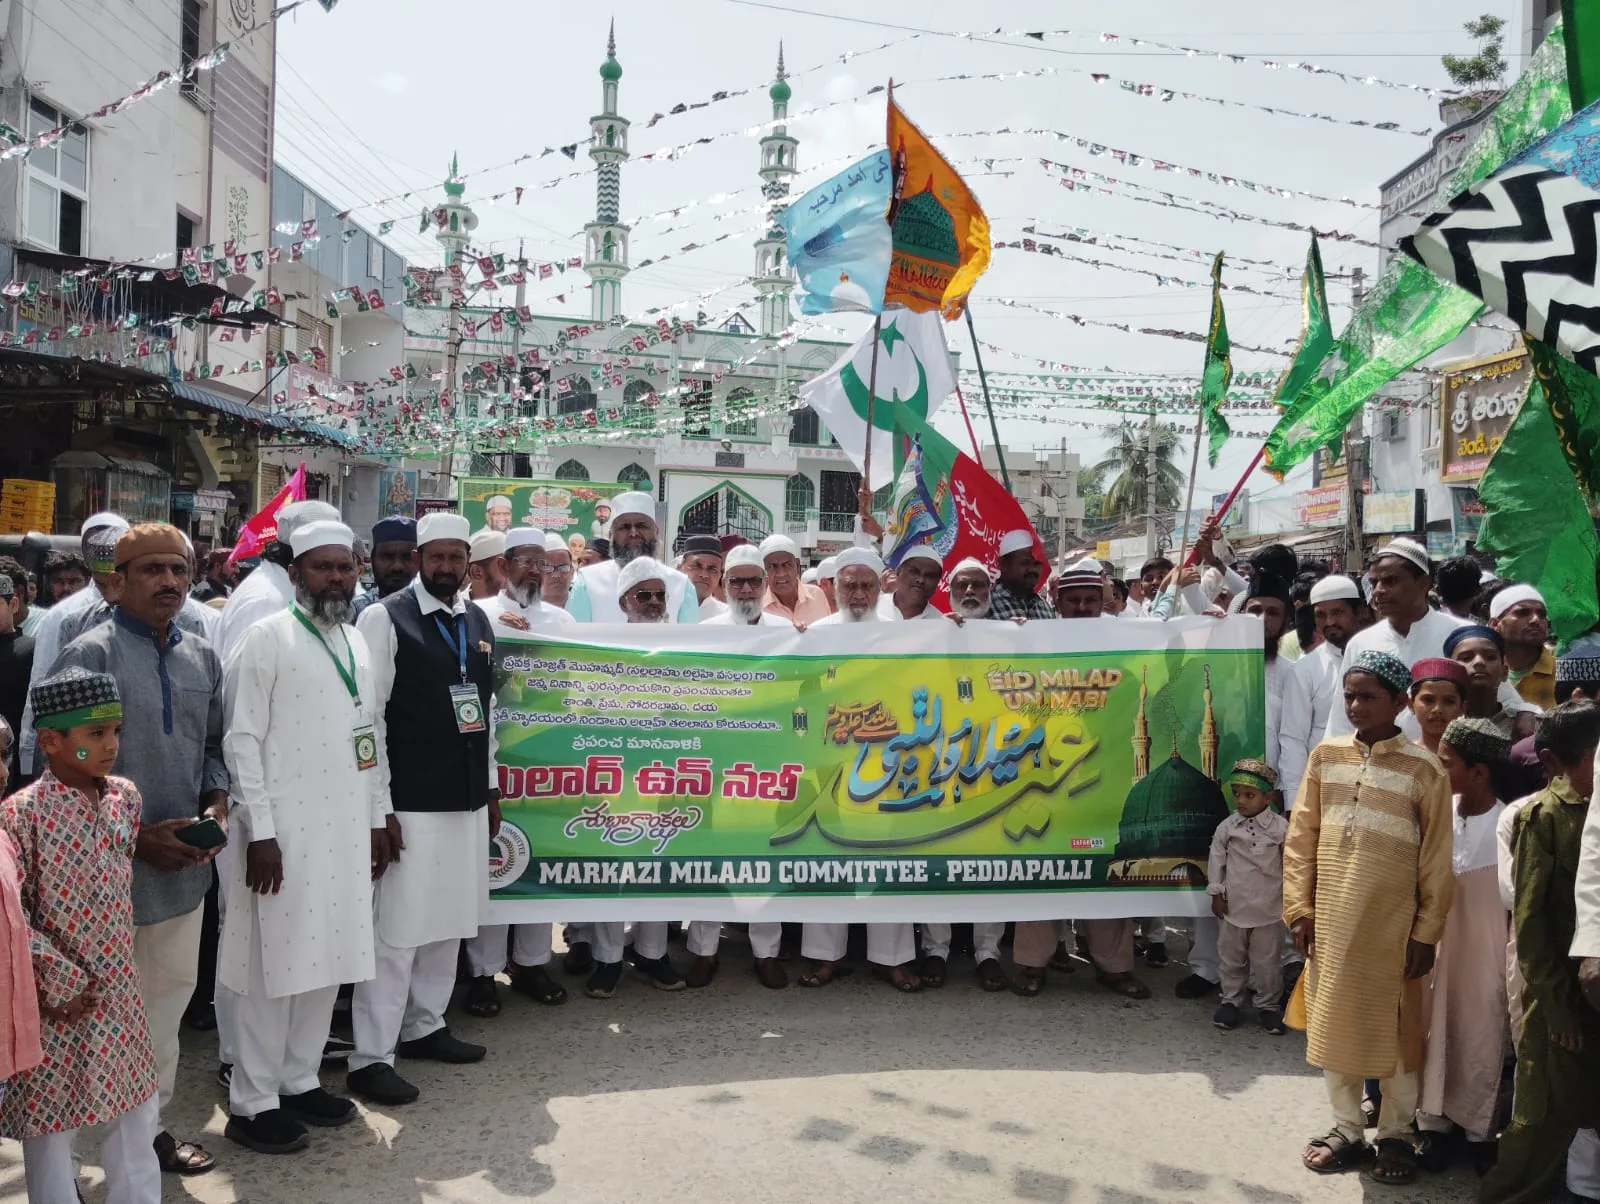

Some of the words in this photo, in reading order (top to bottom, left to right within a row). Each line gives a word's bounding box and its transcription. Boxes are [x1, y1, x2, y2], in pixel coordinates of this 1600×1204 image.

[985, 669, 1035, 691] EID
[1039, 666, 1123, 690] MILAD
[1002, 689, 1044, 712] UN
[1049, 689, 1108, 711] NABI
[572, 736, 623, 750] ప్రపంచ
[634, 758, 713, 797] ఉన్
[538, 861, 661, 885] MARKAZI
[669, 860, 771, 884] MILAAD
[778, 860, 929, 884] COMMITTEE
[946, 859, 1093, 882] PEDDAPALLI
